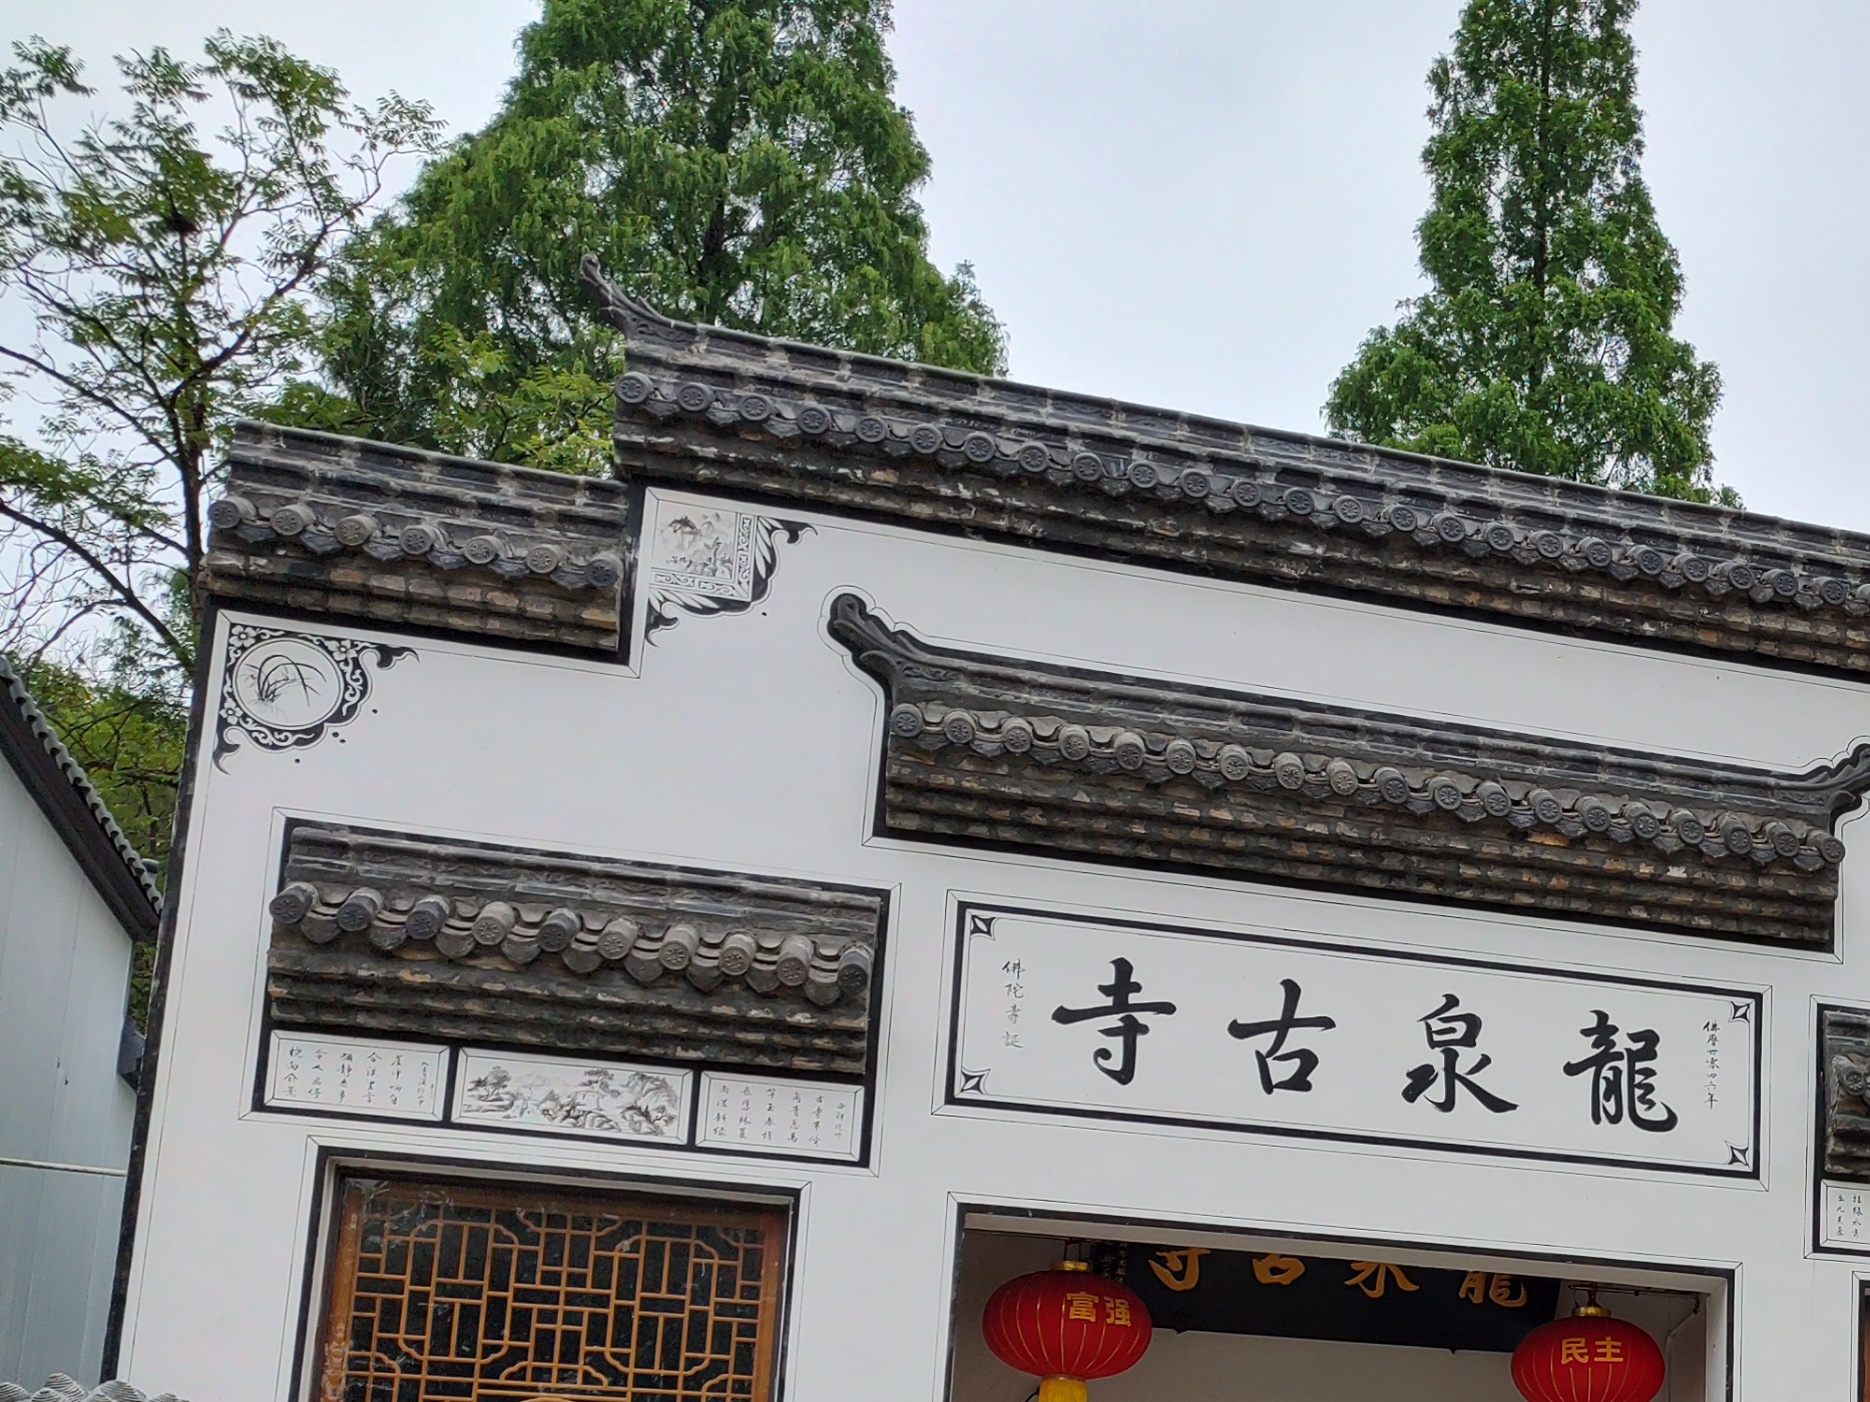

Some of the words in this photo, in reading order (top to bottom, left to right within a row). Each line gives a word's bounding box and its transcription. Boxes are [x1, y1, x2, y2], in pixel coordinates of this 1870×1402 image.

[1051, 957, 1679, 1132] 龍泉古寺
[1066, 1291, 1132, 1328] 富强
[1560, 1336, 1625, 1366] 民主
